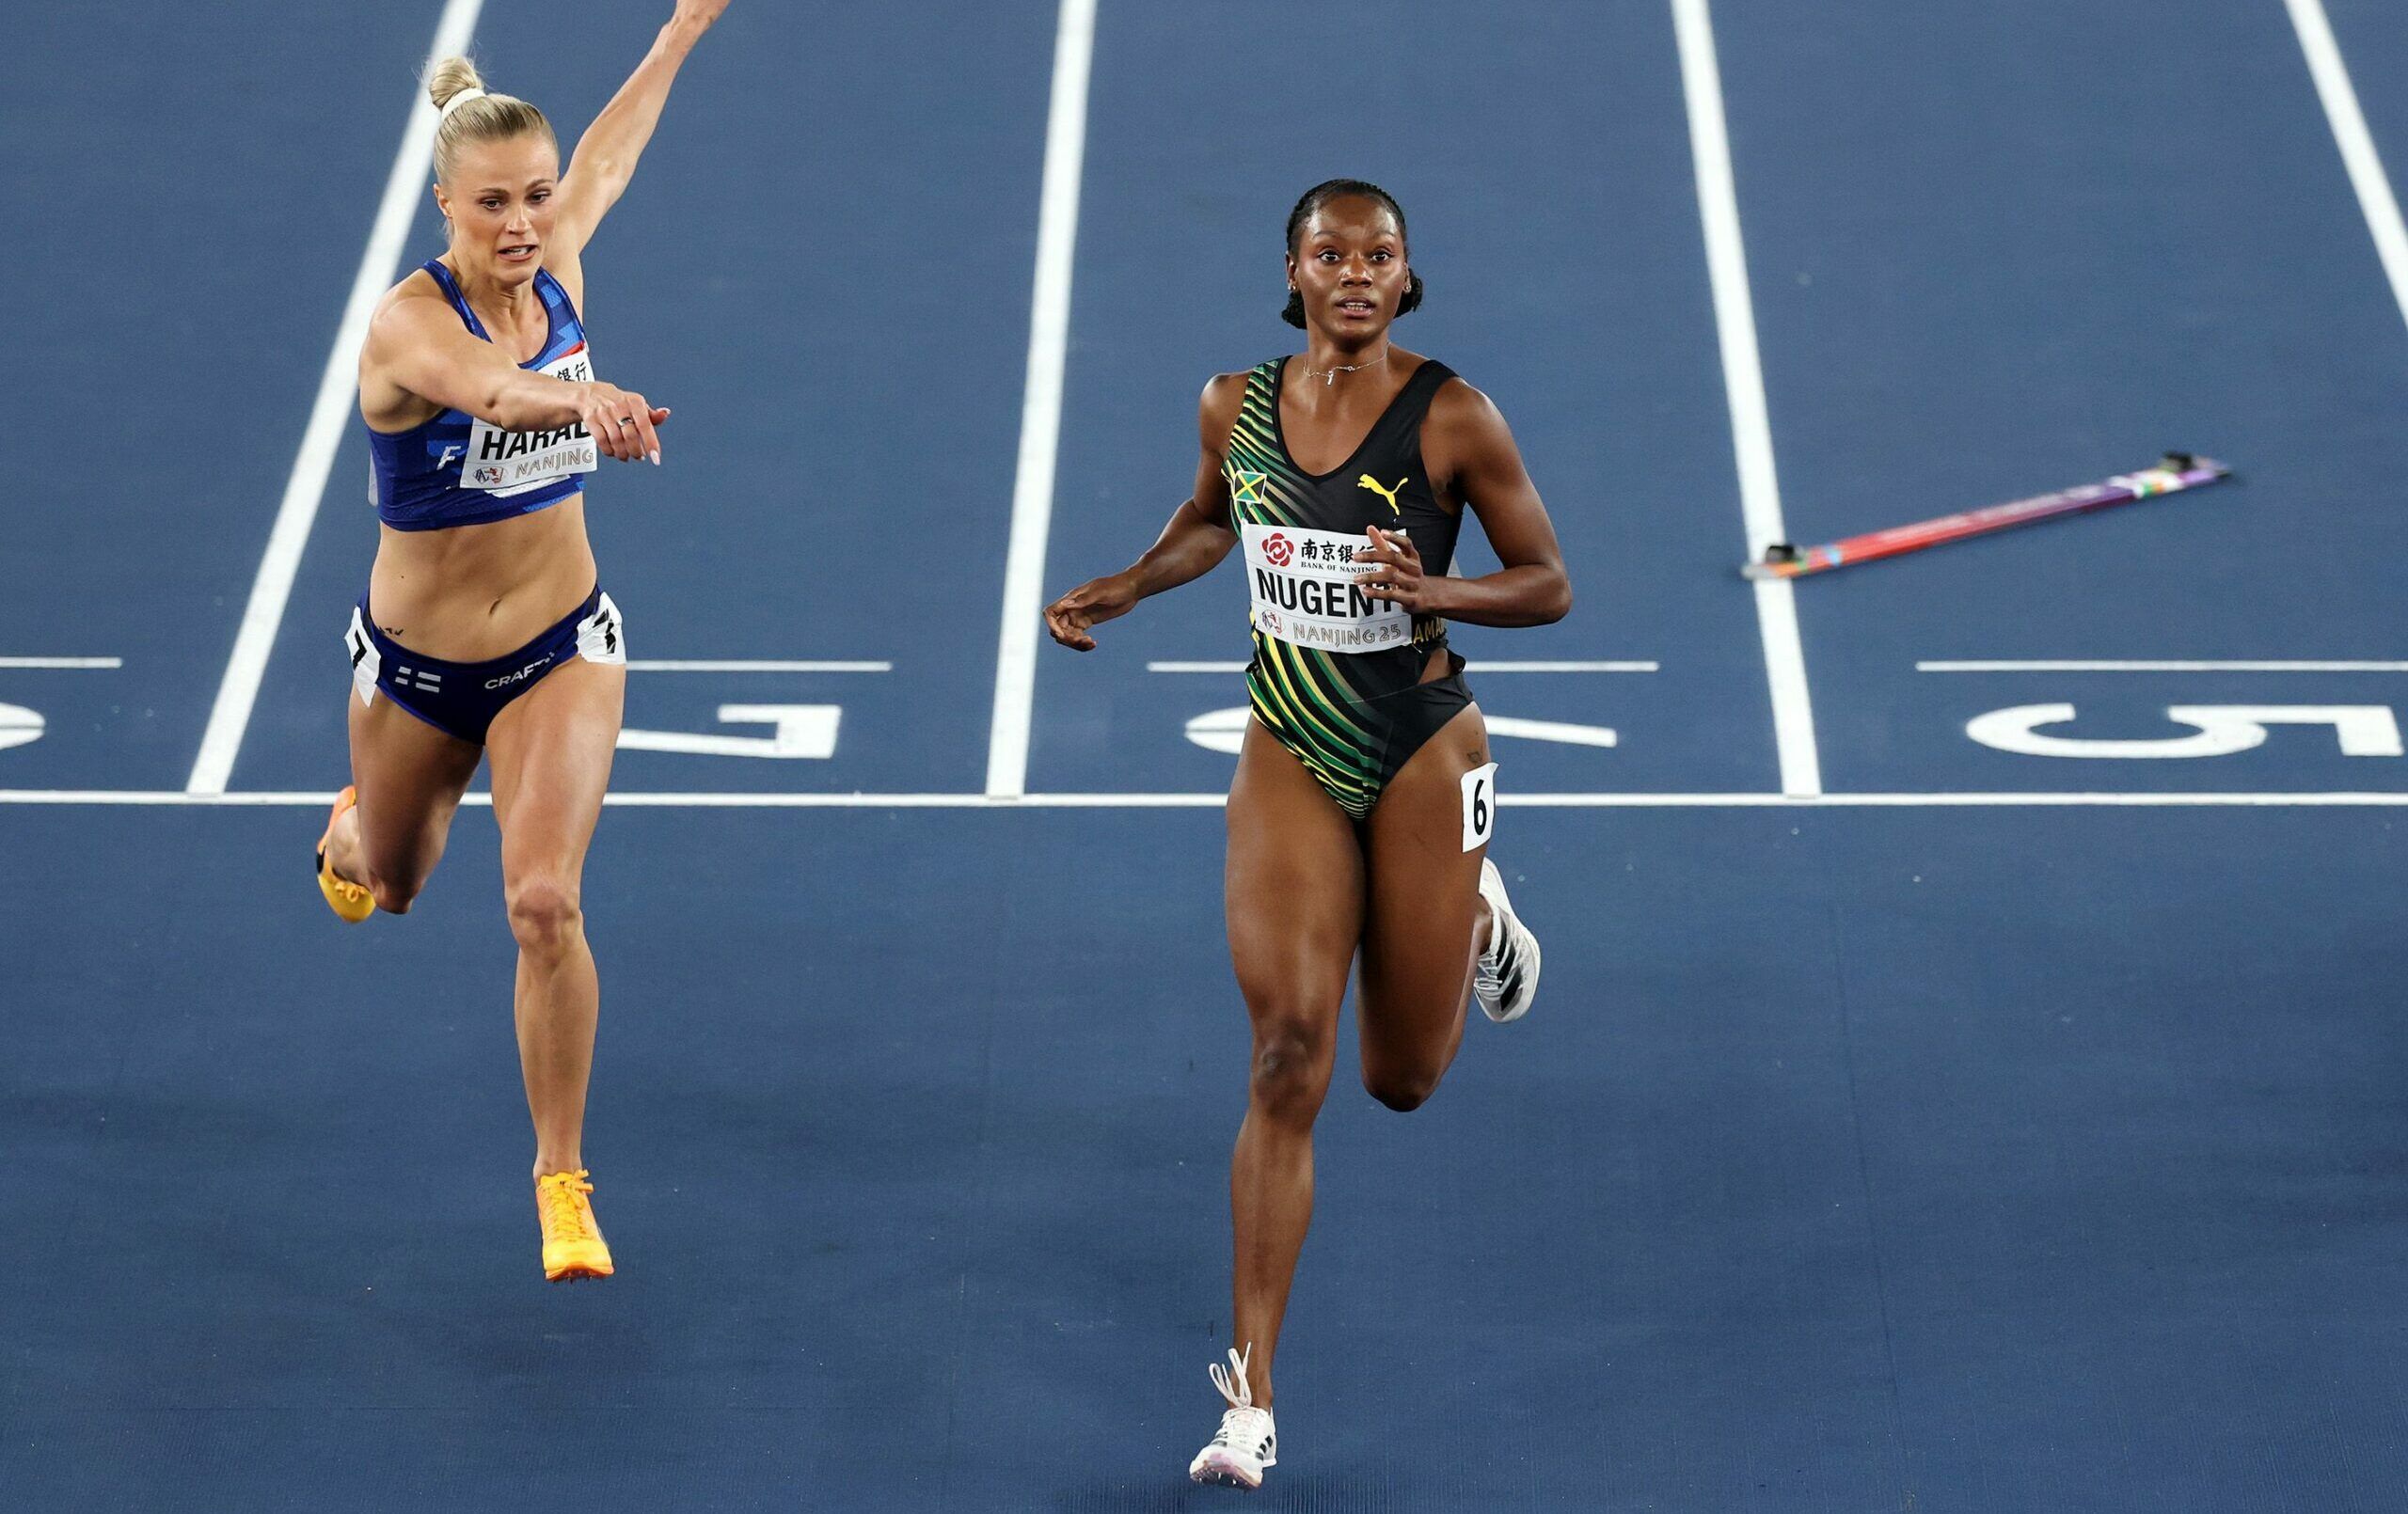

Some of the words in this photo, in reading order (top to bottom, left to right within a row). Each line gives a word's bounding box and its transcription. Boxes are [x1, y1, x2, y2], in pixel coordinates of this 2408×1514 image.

[515, 448, 594, 479] NANJING
[1301, 561, 1323, 570] BANK
[1293, 623, 1375, 648] NANJING
[1379, 624, 1402, 642] 25
[1965, 702, 2404, 759] 5
[1473, 779, 1487, 836] 6
